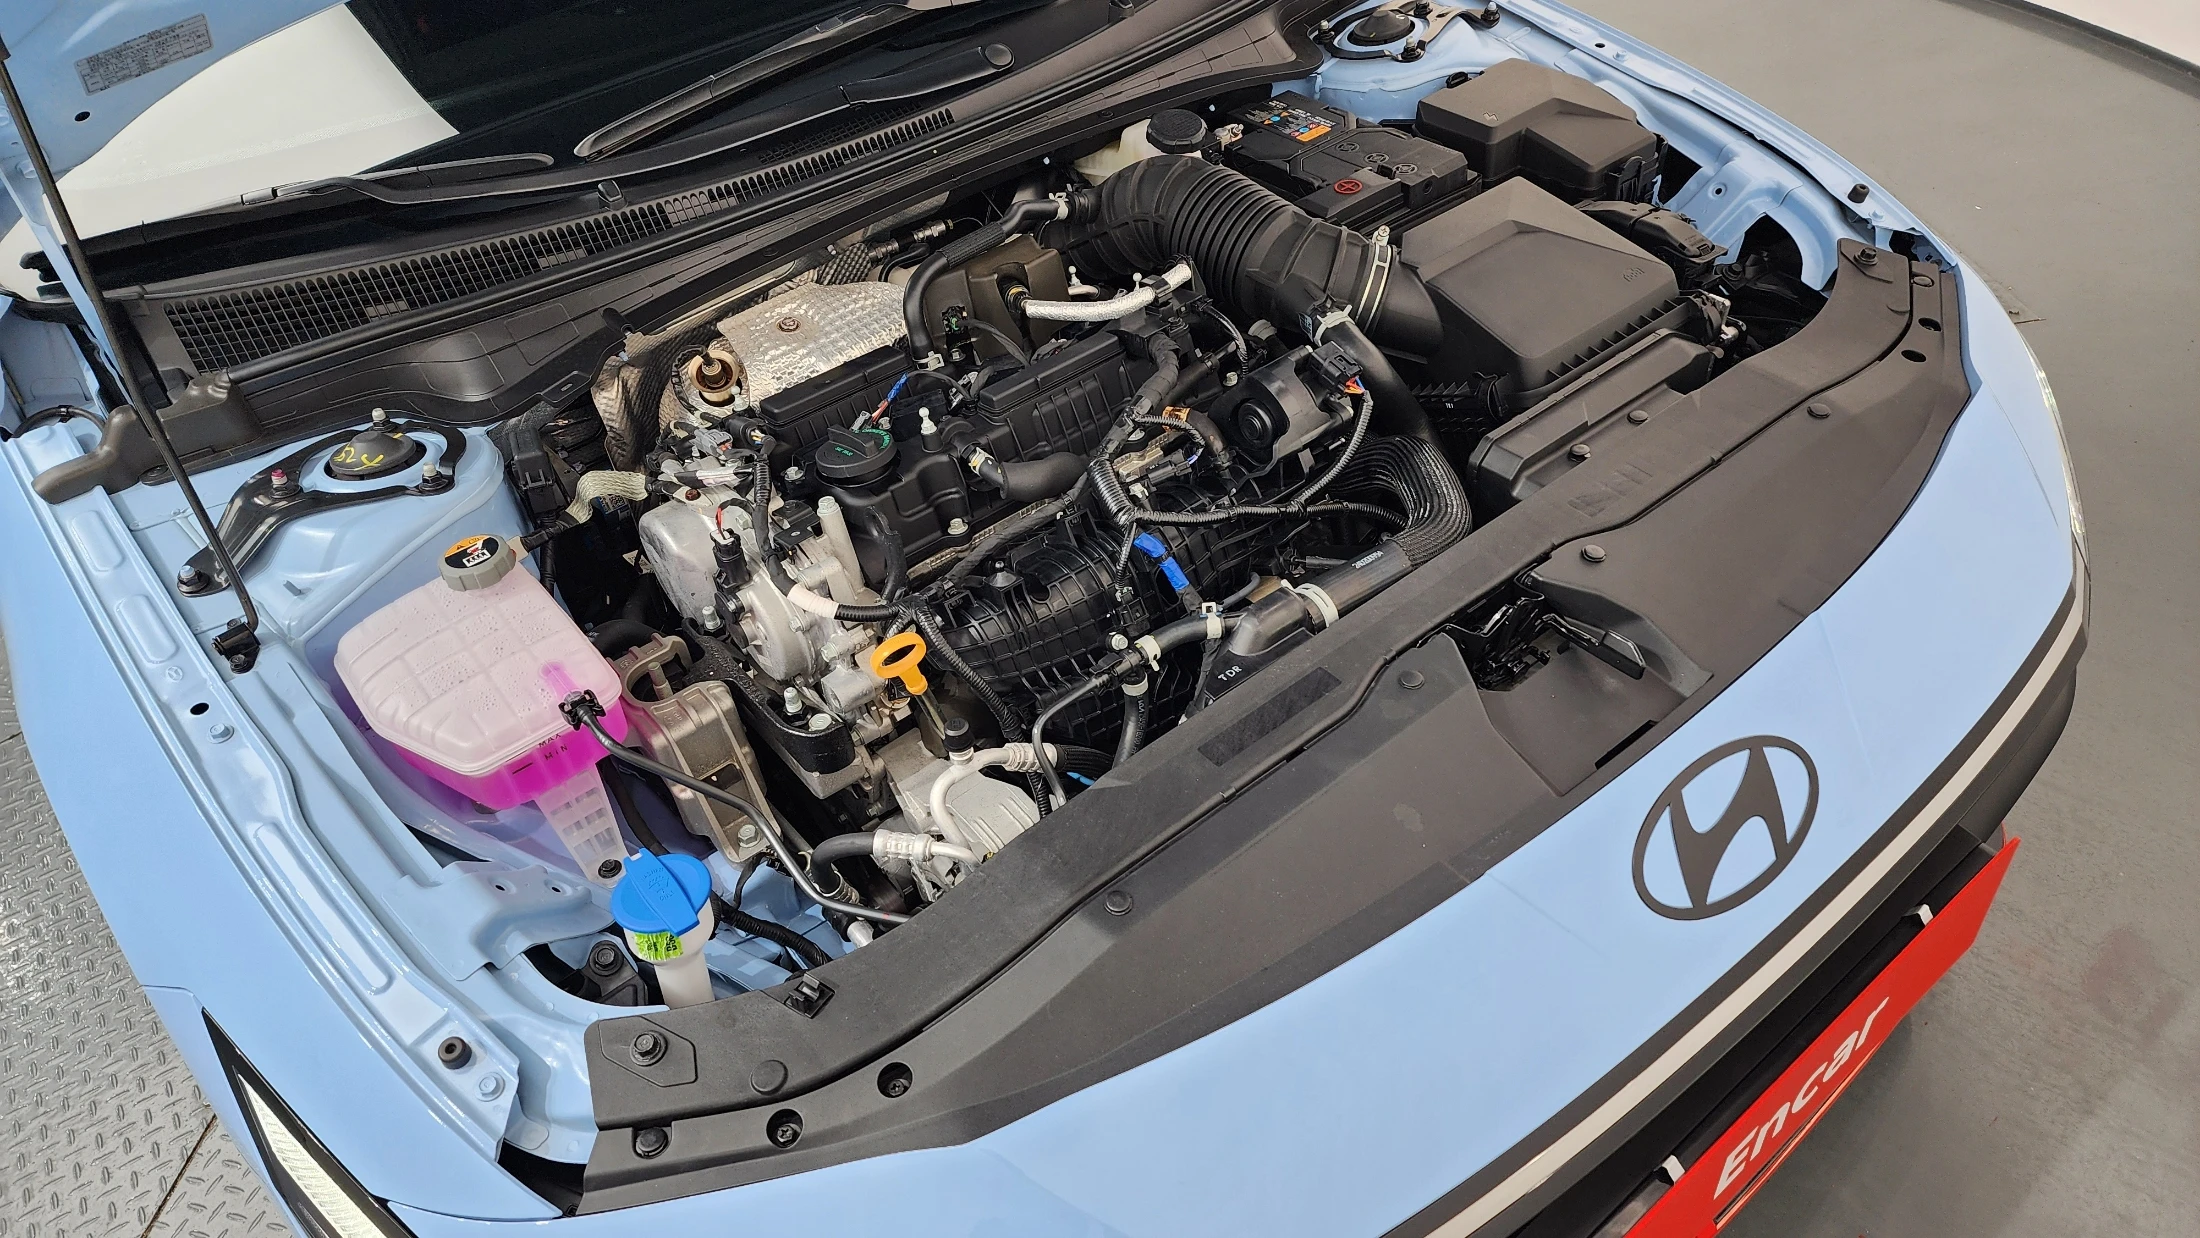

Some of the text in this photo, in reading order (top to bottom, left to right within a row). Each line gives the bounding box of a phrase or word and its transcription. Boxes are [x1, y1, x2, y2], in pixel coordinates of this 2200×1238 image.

[1217, 665, 1242, 681] TDR
[538, 733, 562, 748] MAX
[544, 744, 568, 761] MIN
[1713, 996, 1890, 1200] Encar
